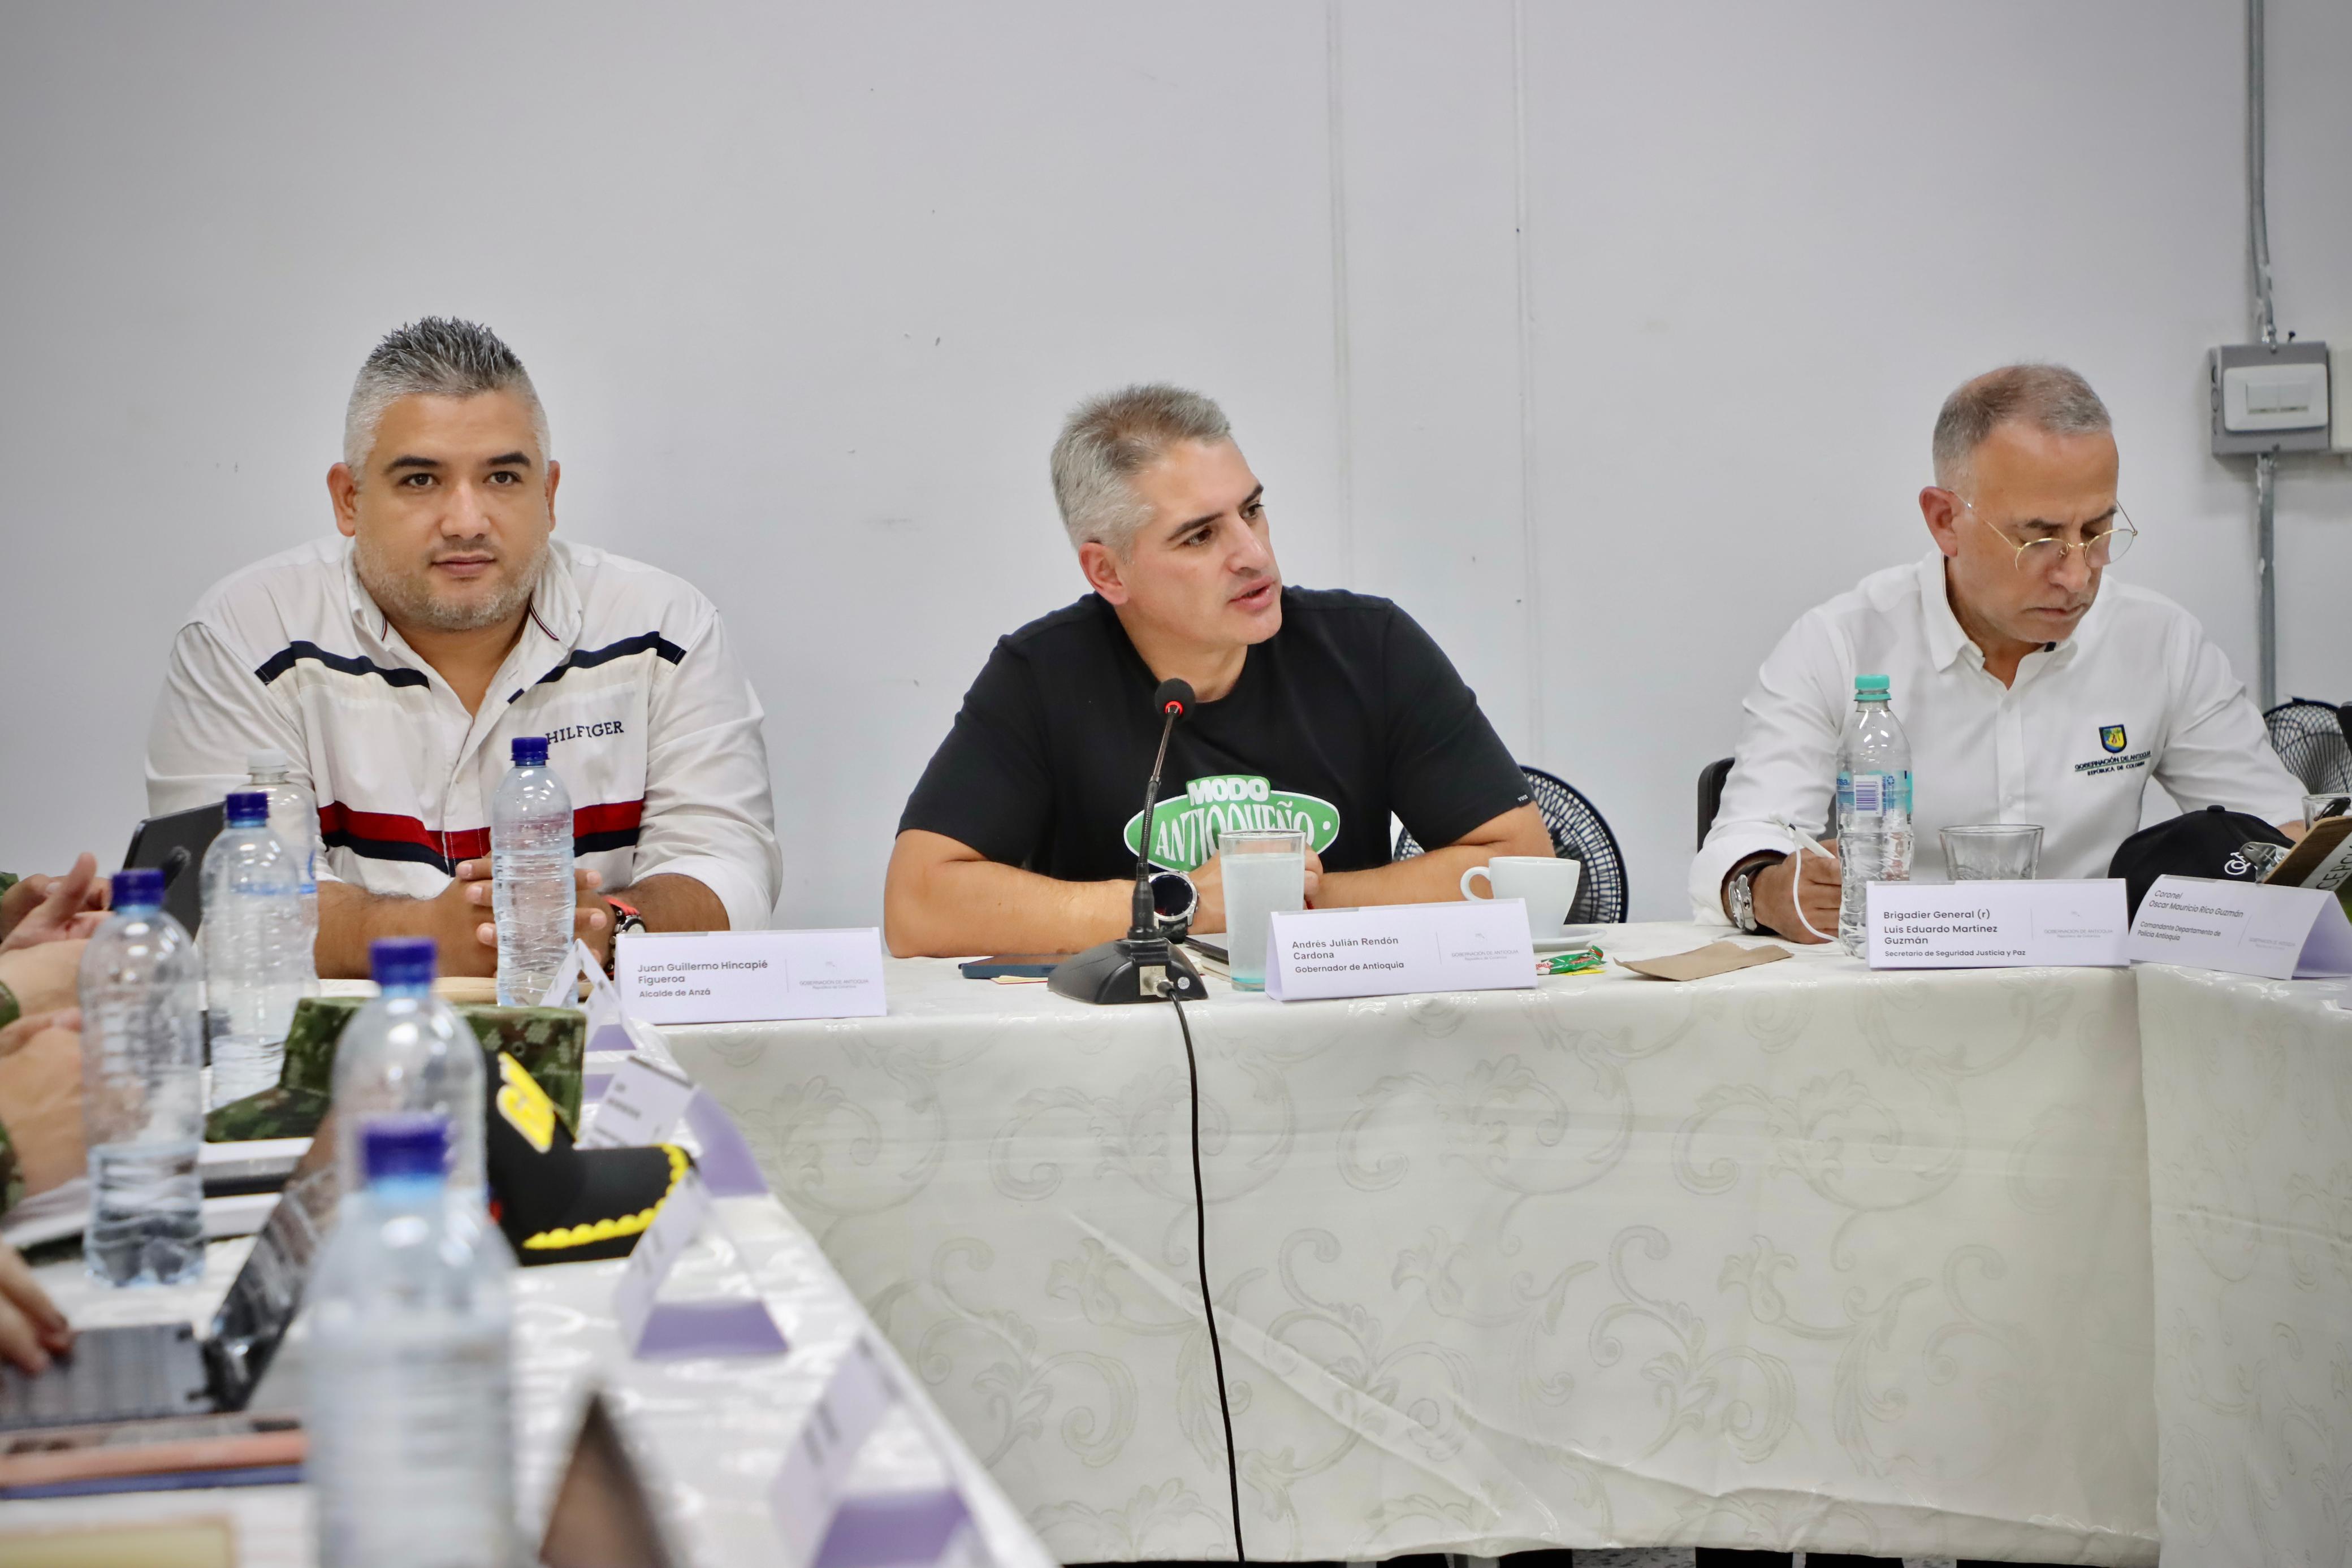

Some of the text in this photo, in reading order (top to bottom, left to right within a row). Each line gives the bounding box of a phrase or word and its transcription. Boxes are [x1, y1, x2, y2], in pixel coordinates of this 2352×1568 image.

[545, 721, 624, 745] HILFIGER
[2074, 756, 2120, 770] GOBERNACIÓN
[1188, 778, 1269, 807] MODO
[2155, 890, 2183, 899] Coronel
[1883, 909, 1991, 921] Brigadier General (r)
[2148, 900, 2244, 918] Oscar Mauricio Rico Guzmán
[1884, 924, 1998, 933] Luis Eduardo Martínez
[2141, 921, 2174, 931] Comandante
[2175, 925, 2213, 936] Departamento
[1292, 936, 1399, 949] Andrés Julián Rendón
[1884, 936, 1928, 945] Guzmán
[2155, 933, 2180, 942] Antioquia
[1293, 951, 1334, 960] Cardona
[638, 960, 768, 973] Juan Guillermo Hincapié
[1295, 964, 1347, 973] Gobernador
[1363, 961, 1404, 972] Antioquia
[638, 975, 685, 986] Figueroa
[639, 989, 673, 998] Alcalde
[689, 987, 711, 996] Anzá
